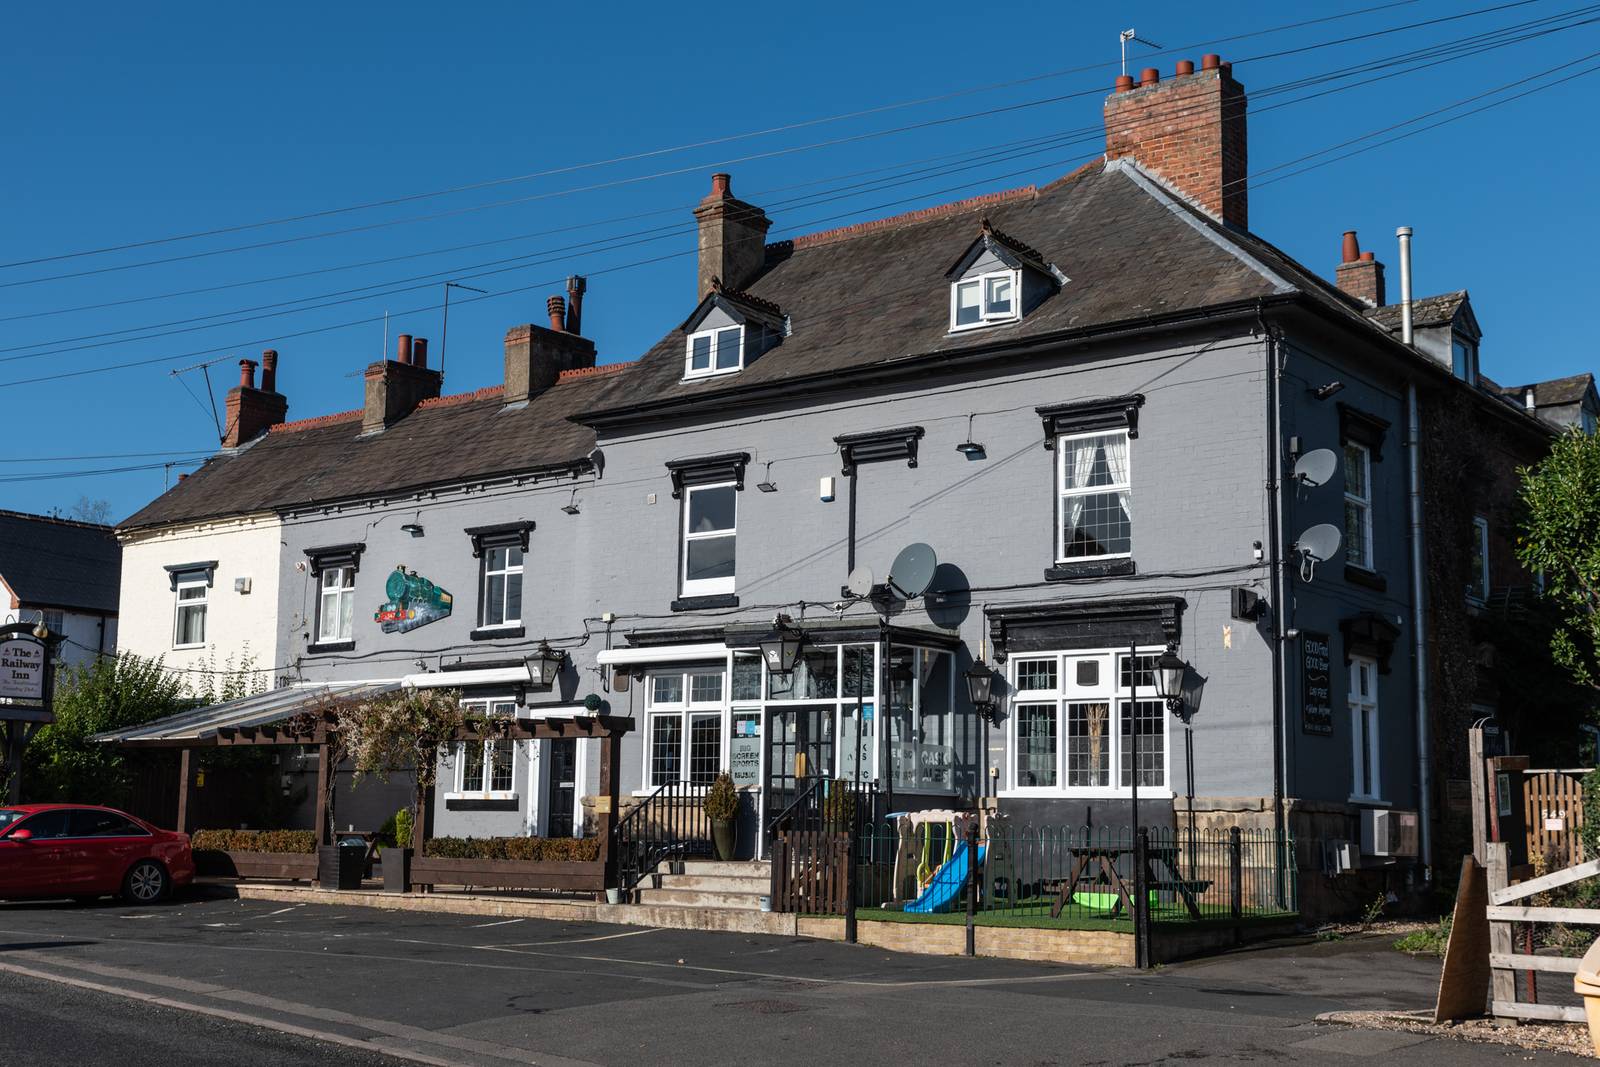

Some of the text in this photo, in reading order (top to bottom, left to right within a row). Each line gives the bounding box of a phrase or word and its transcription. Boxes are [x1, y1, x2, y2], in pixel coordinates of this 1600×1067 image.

[12, 647, 32, 657] The
[1, 658, 41, 672] Railway
[12, 670, 30, 679] Inn
[732, 752, 760, 760] SCREEN
[921, 750, 951, 766] CASK
[732, 760, 760, 768] SPORTS
[734, 771, 756, 779] MUSIC
[1541, 809, 1566, 819] 549
